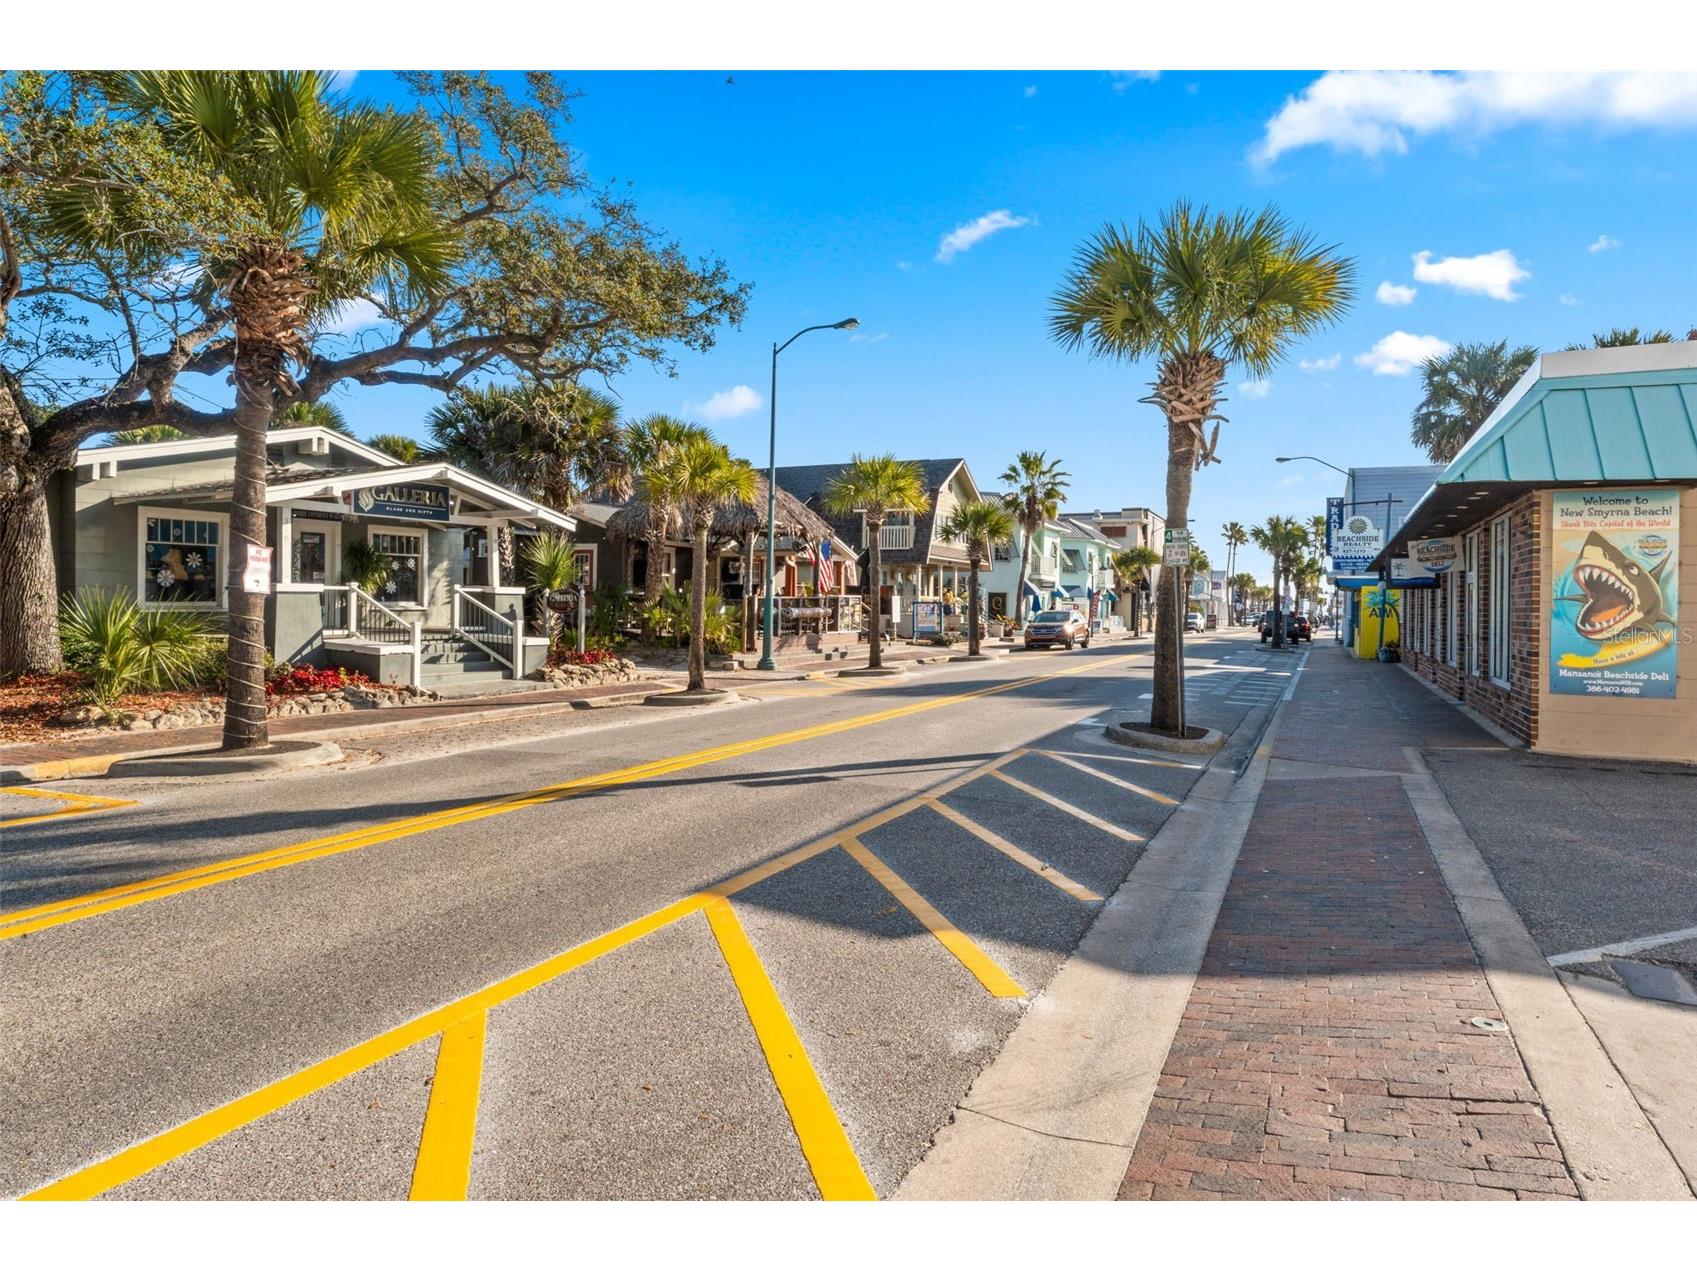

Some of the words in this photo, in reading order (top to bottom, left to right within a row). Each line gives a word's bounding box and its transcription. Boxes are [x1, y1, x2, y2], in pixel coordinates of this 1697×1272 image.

[372, 486, 447, 507] GALLERIA
[1582, 496, 1632, 506] Welcome
[1636, 495, 1649, 505] to
[1560, 507, 1584, 517] New
[1587, 507, 1630, 519] Smyrna
[1634, 506, 1673, 517] Beach!
[1336, 535, 1379, 543] BEACHSIDE
[1416, 544, 1456, 555] BEACHSIDE
[1604, 670, 1648, 680] Beachside
[1651, 671, 1670, 681] Deli
